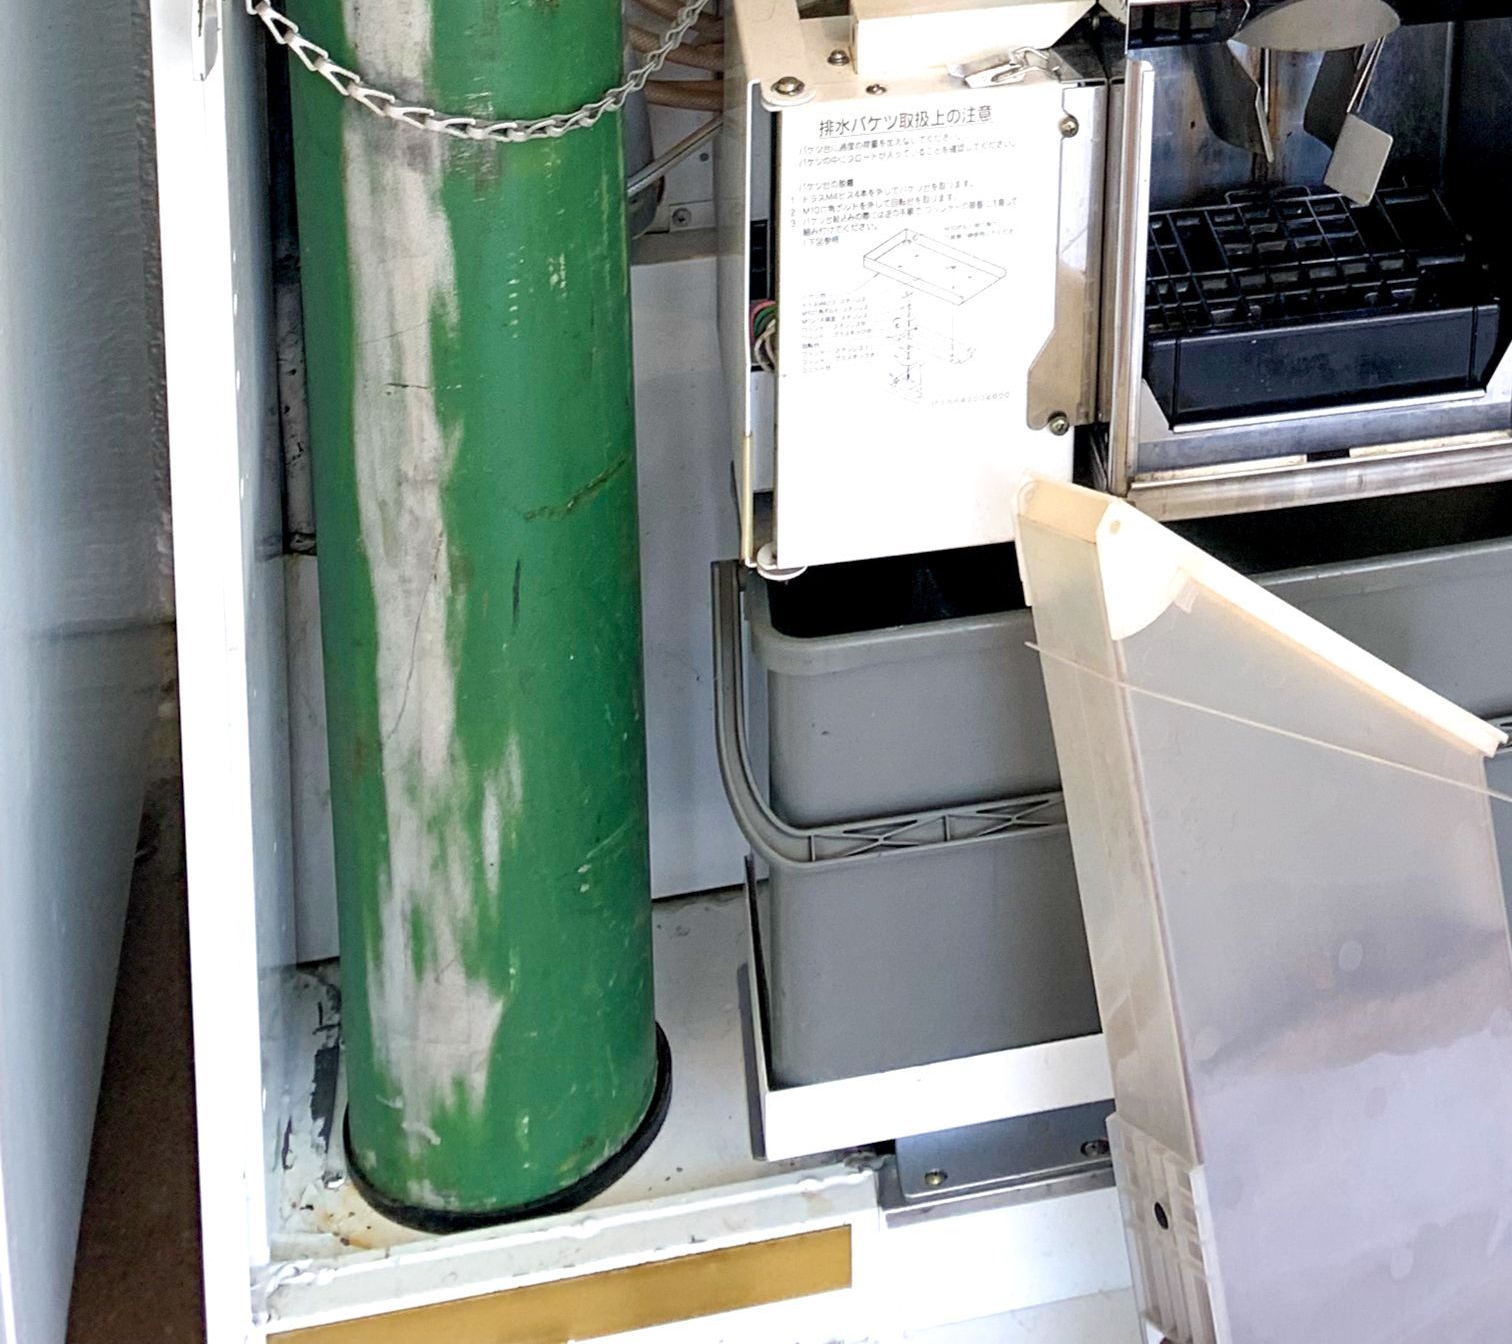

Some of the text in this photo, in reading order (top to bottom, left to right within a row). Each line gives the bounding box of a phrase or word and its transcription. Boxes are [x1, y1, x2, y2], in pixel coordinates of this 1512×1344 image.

[819, 104, 993, 137] 排水バケツ取扱上の注意
